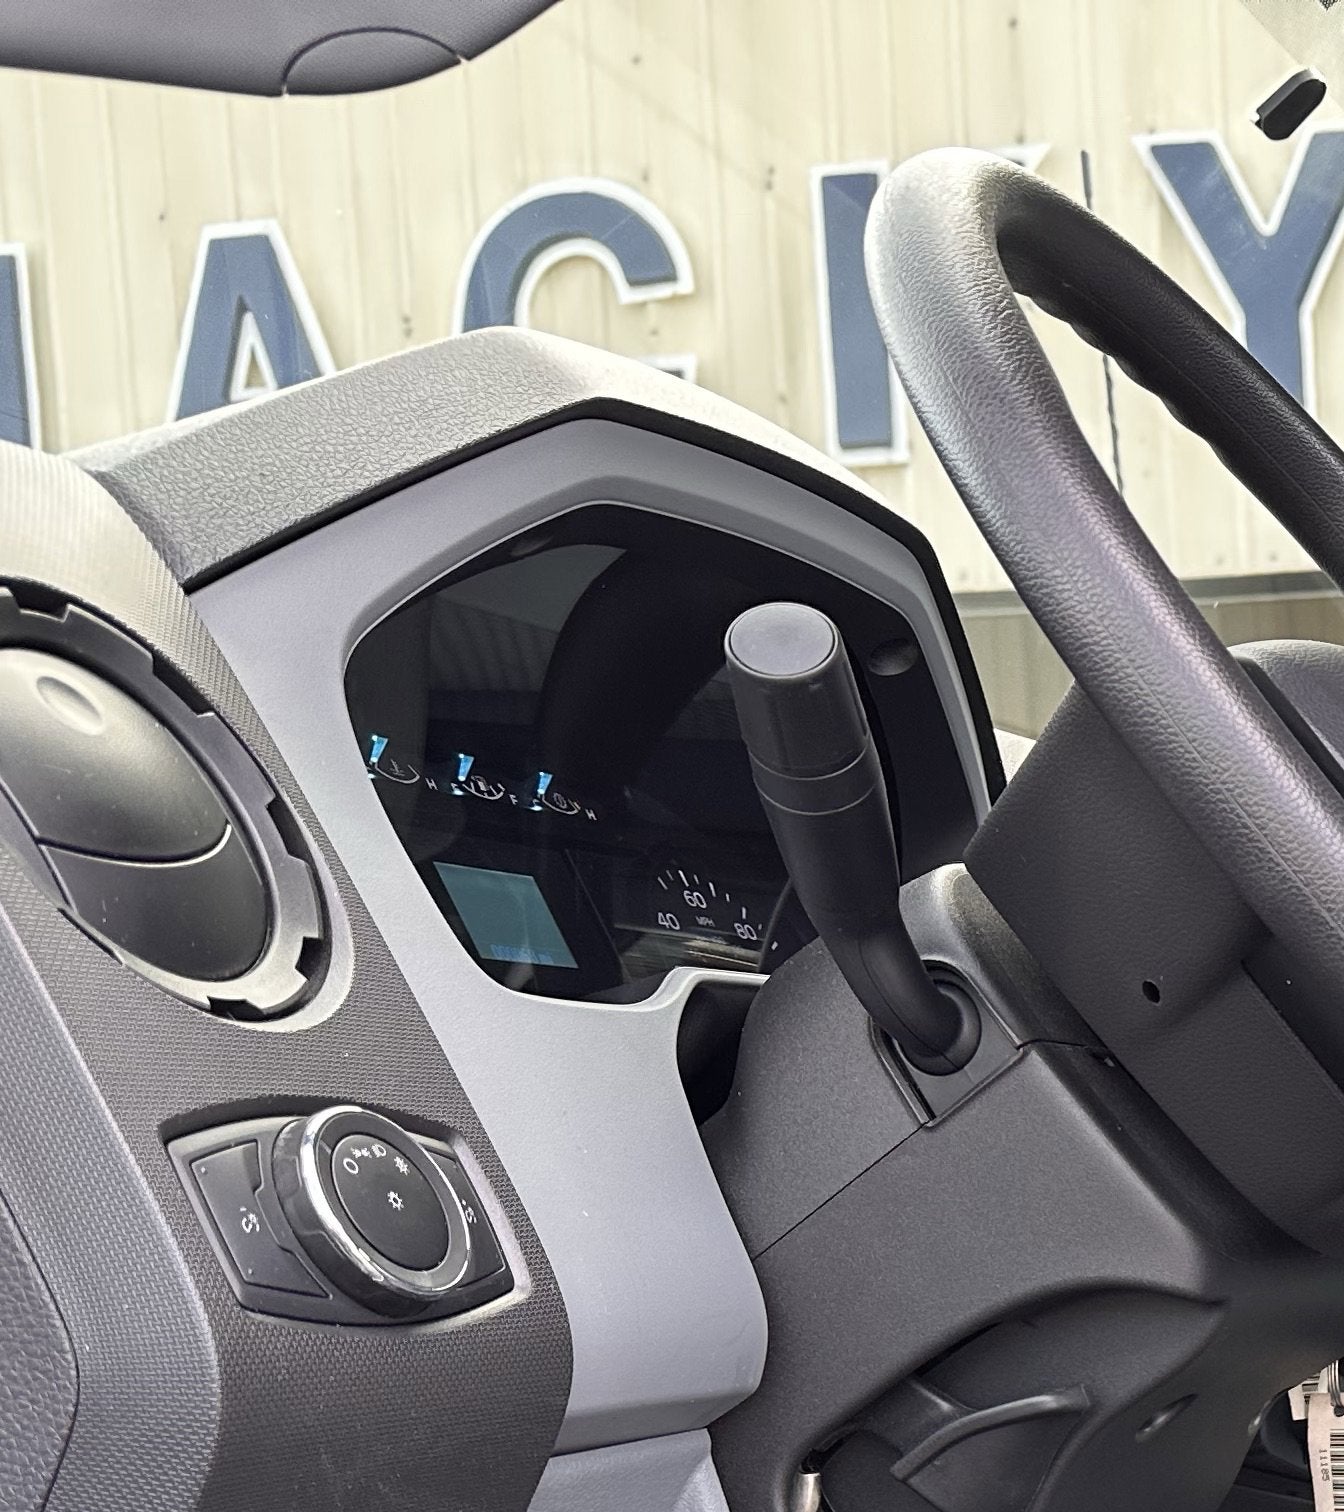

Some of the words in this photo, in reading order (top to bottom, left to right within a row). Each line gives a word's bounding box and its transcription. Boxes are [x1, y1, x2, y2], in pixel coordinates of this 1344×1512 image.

[683, 890, 708, 909] 60
[657, 911, 681, 931] 40
[734, 922, 758, 941] 80
